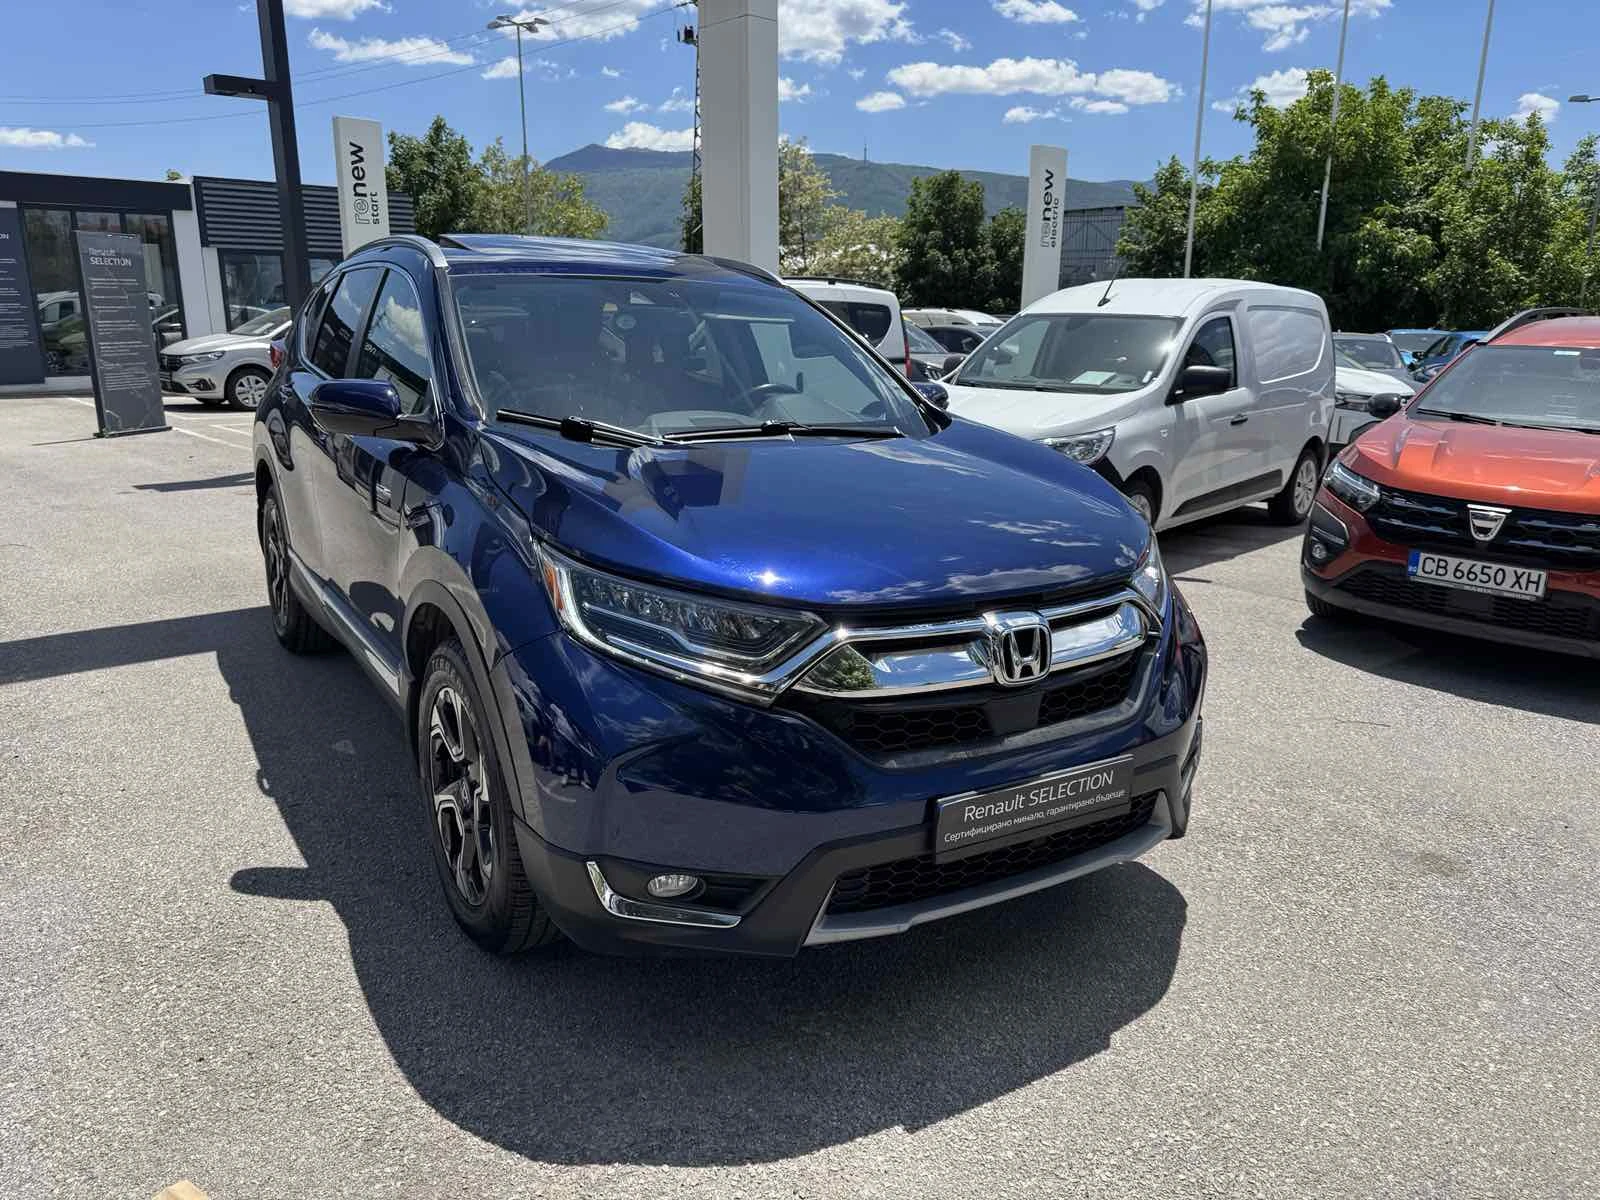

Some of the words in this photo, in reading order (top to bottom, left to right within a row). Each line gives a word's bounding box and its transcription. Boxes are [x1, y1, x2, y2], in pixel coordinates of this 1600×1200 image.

[349, 141, 370, 225] renew
[370, 191, 380, 225] start
[90, 256, 132, 267] SELECTION
[1421, 556, 1449, 577] CB
[1453, 561, 1506, 586] 6650
[1510, 569, 1542, 593] XH
[963, 793, 1025, 823] Renault
[1028, 769, 1114, 807] SELECTION
[944, 818, 1013, 843] Сертифицирано
[1046, 797, 1095, 817] гарантирано
